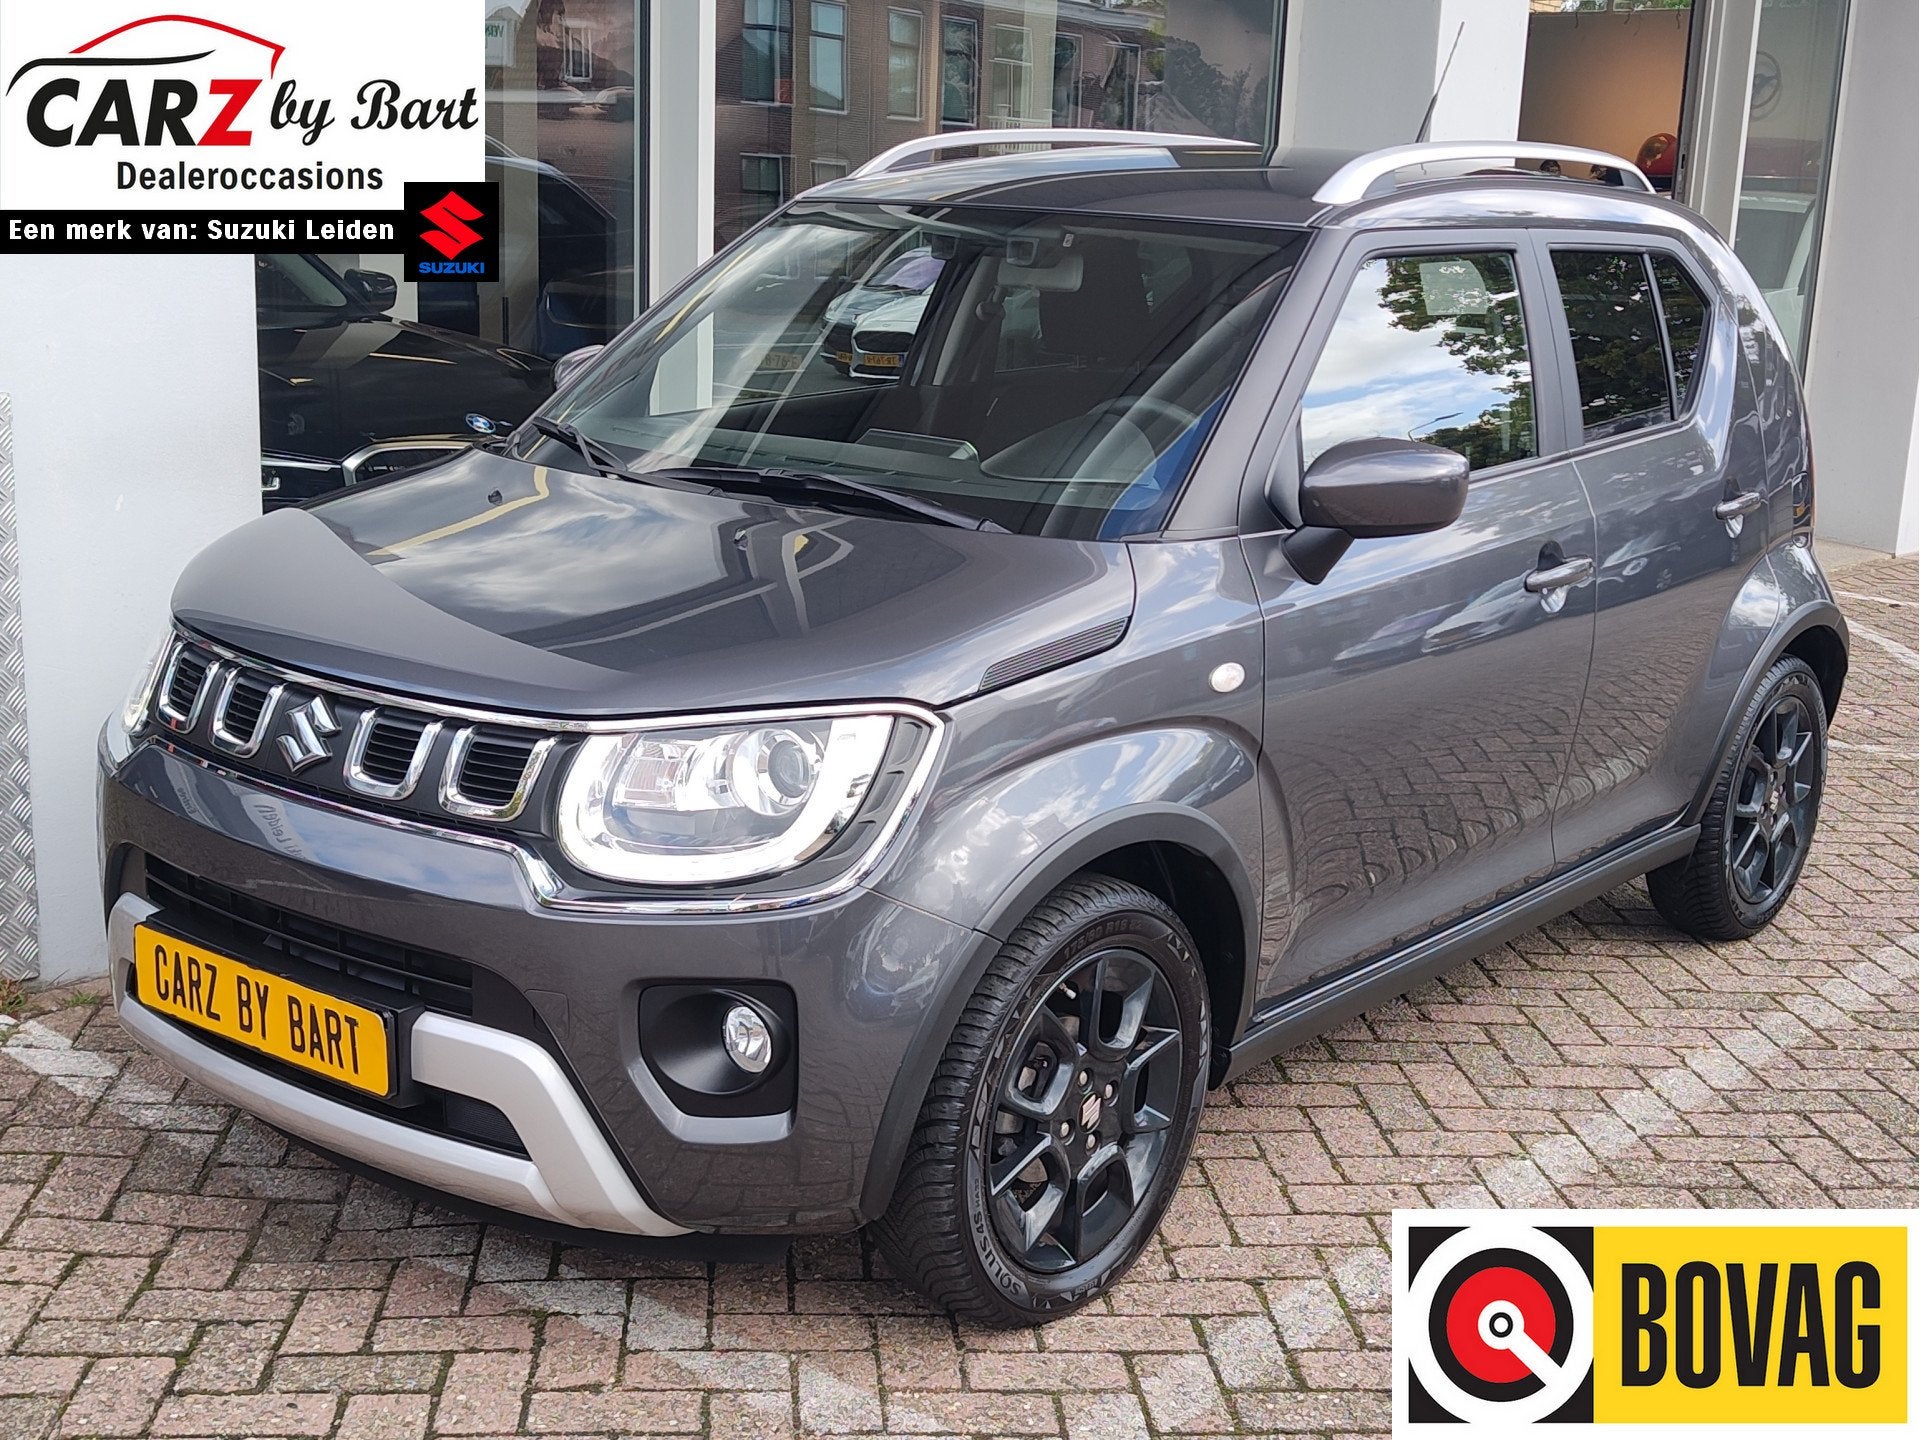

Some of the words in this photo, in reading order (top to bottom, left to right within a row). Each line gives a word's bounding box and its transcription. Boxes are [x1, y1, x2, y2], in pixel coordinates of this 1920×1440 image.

[154, 944, 221, 1022] CARZ
[236, 974, 270, 1041] BY
[287, 994, 360, 1075] BART
[973, 1210, 985, 1234] 4S
[980, 1235, 1022, 1296] SOLUS
